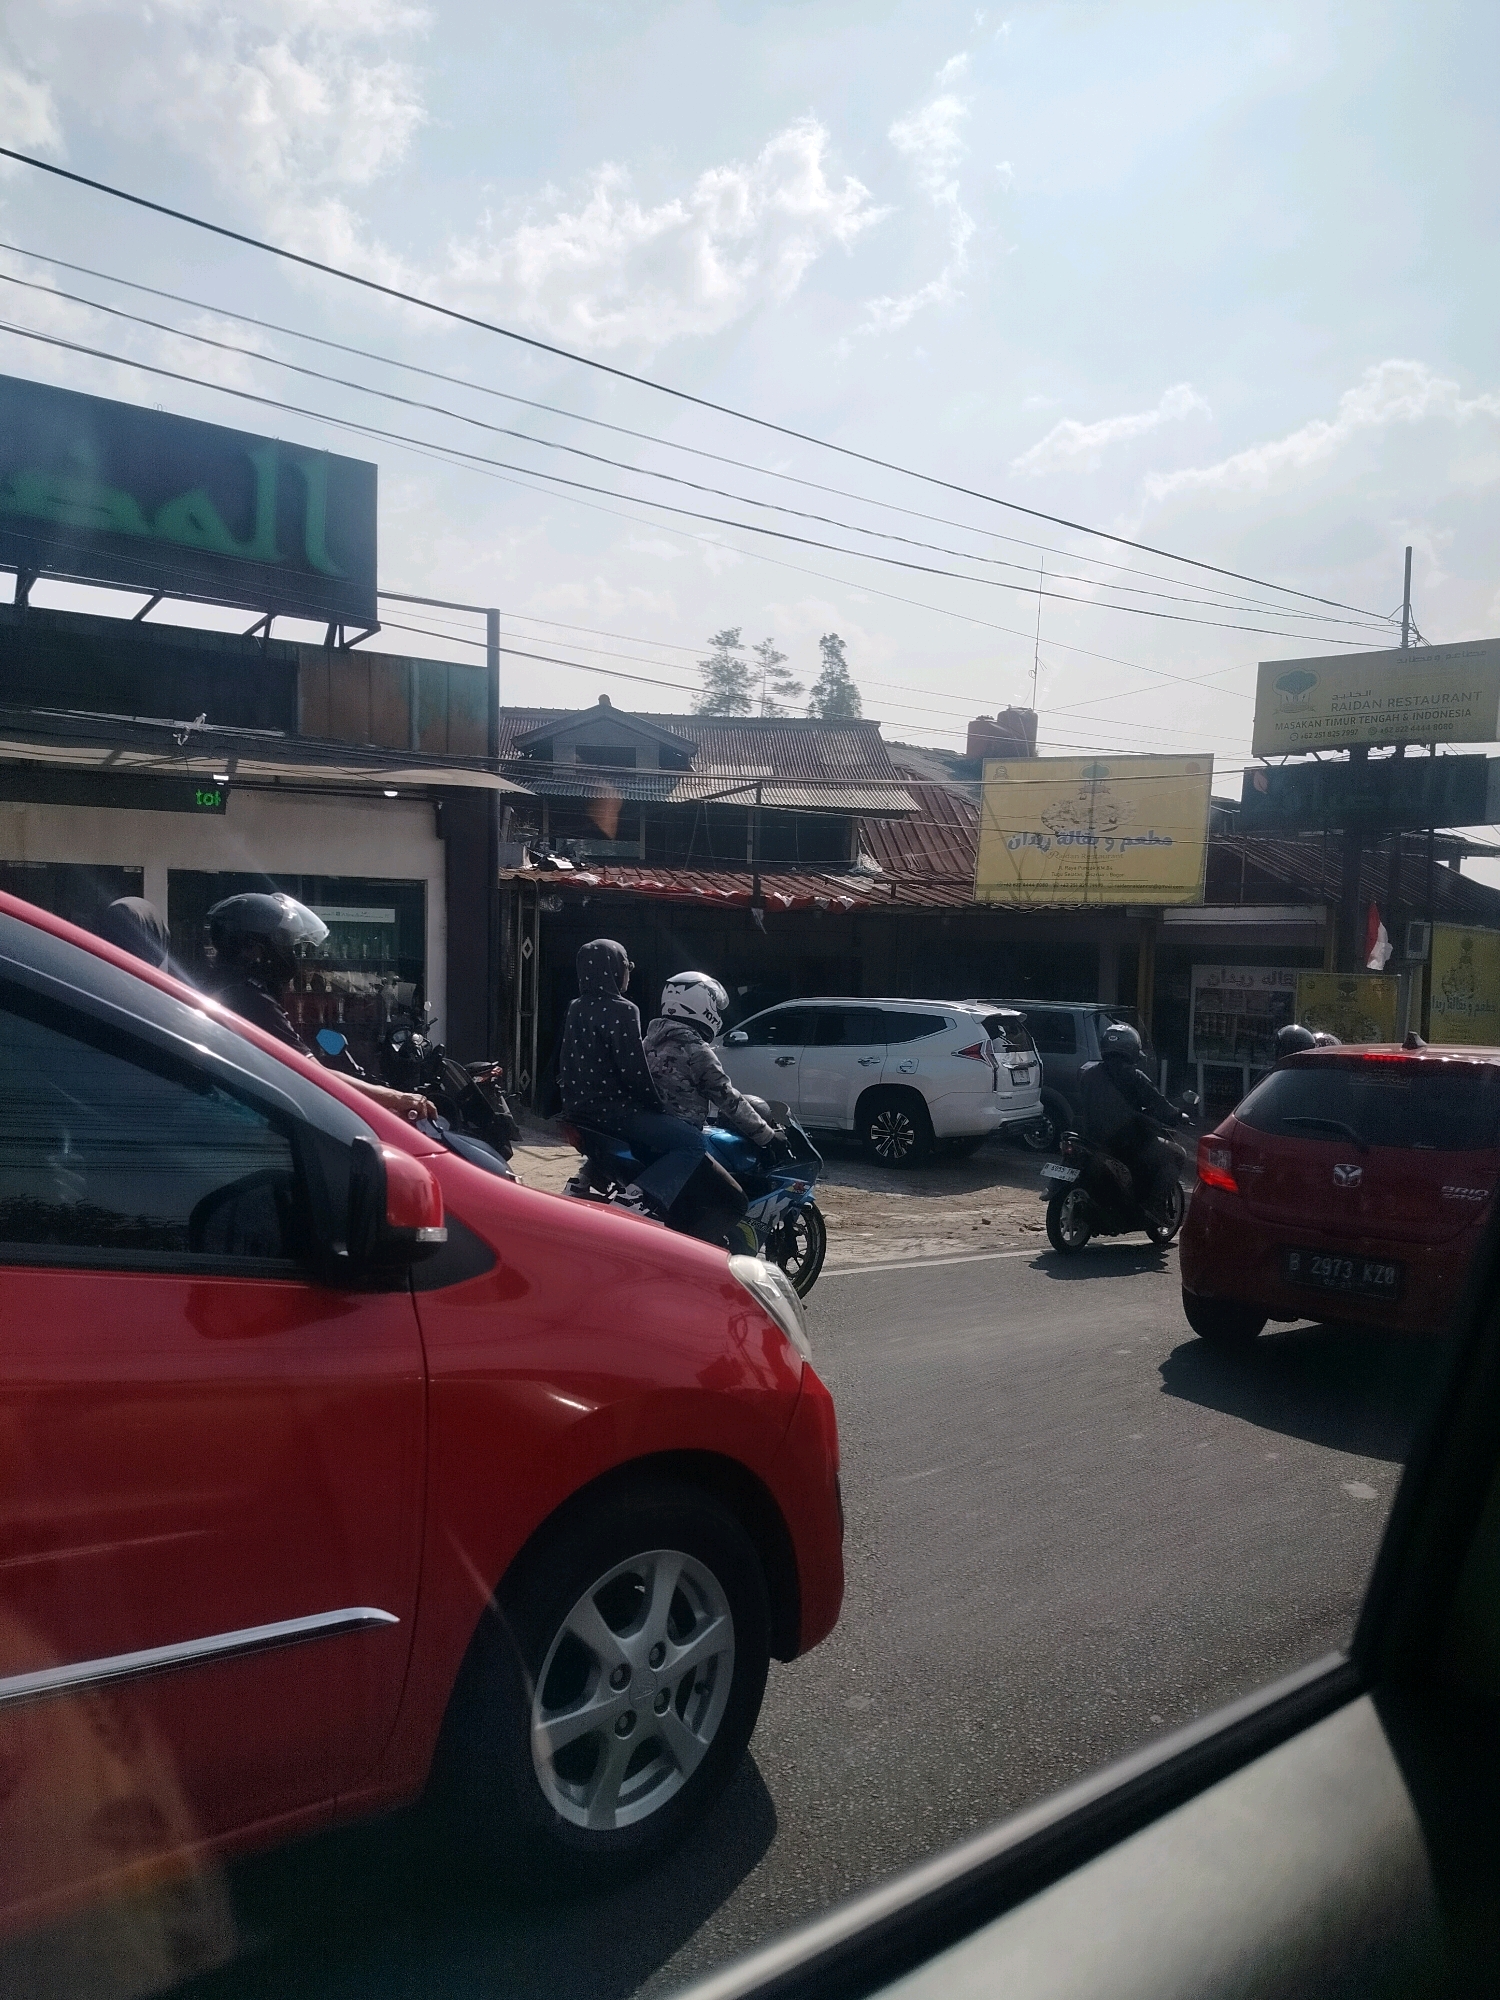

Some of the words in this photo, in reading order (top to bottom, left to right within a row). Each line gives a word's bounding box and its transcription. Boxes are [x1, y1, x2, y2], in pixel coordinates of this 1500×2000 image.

[1331, 698, 1382, 712] RAIDAN
[1388, 690, 1483, 708] RESTAURANT
[1275, 718, 1322, 731] MASAKAN
[1326, 715, 1356, 727] TIMUR
[1358, 713, 1400, 725] TENGAH
[1402, 713, 1409, 722] &
[1412, 708, 1472, 721] INDONESIA
[1379, 726, 1394, 735] +62
[1395, 725, 1409, 733] 822
[1410, 724, 1432, 732] 4444
[1432, 722, 1455, 731] 8080
[1300, 732, 1313, 740] +62
[1314, 731, 1326, 739] 251
[1104, 837, 1117, 852] و
[1289, 1252, 1301, 1271] B
[1311, 1256, 1354, 1279] 2973
